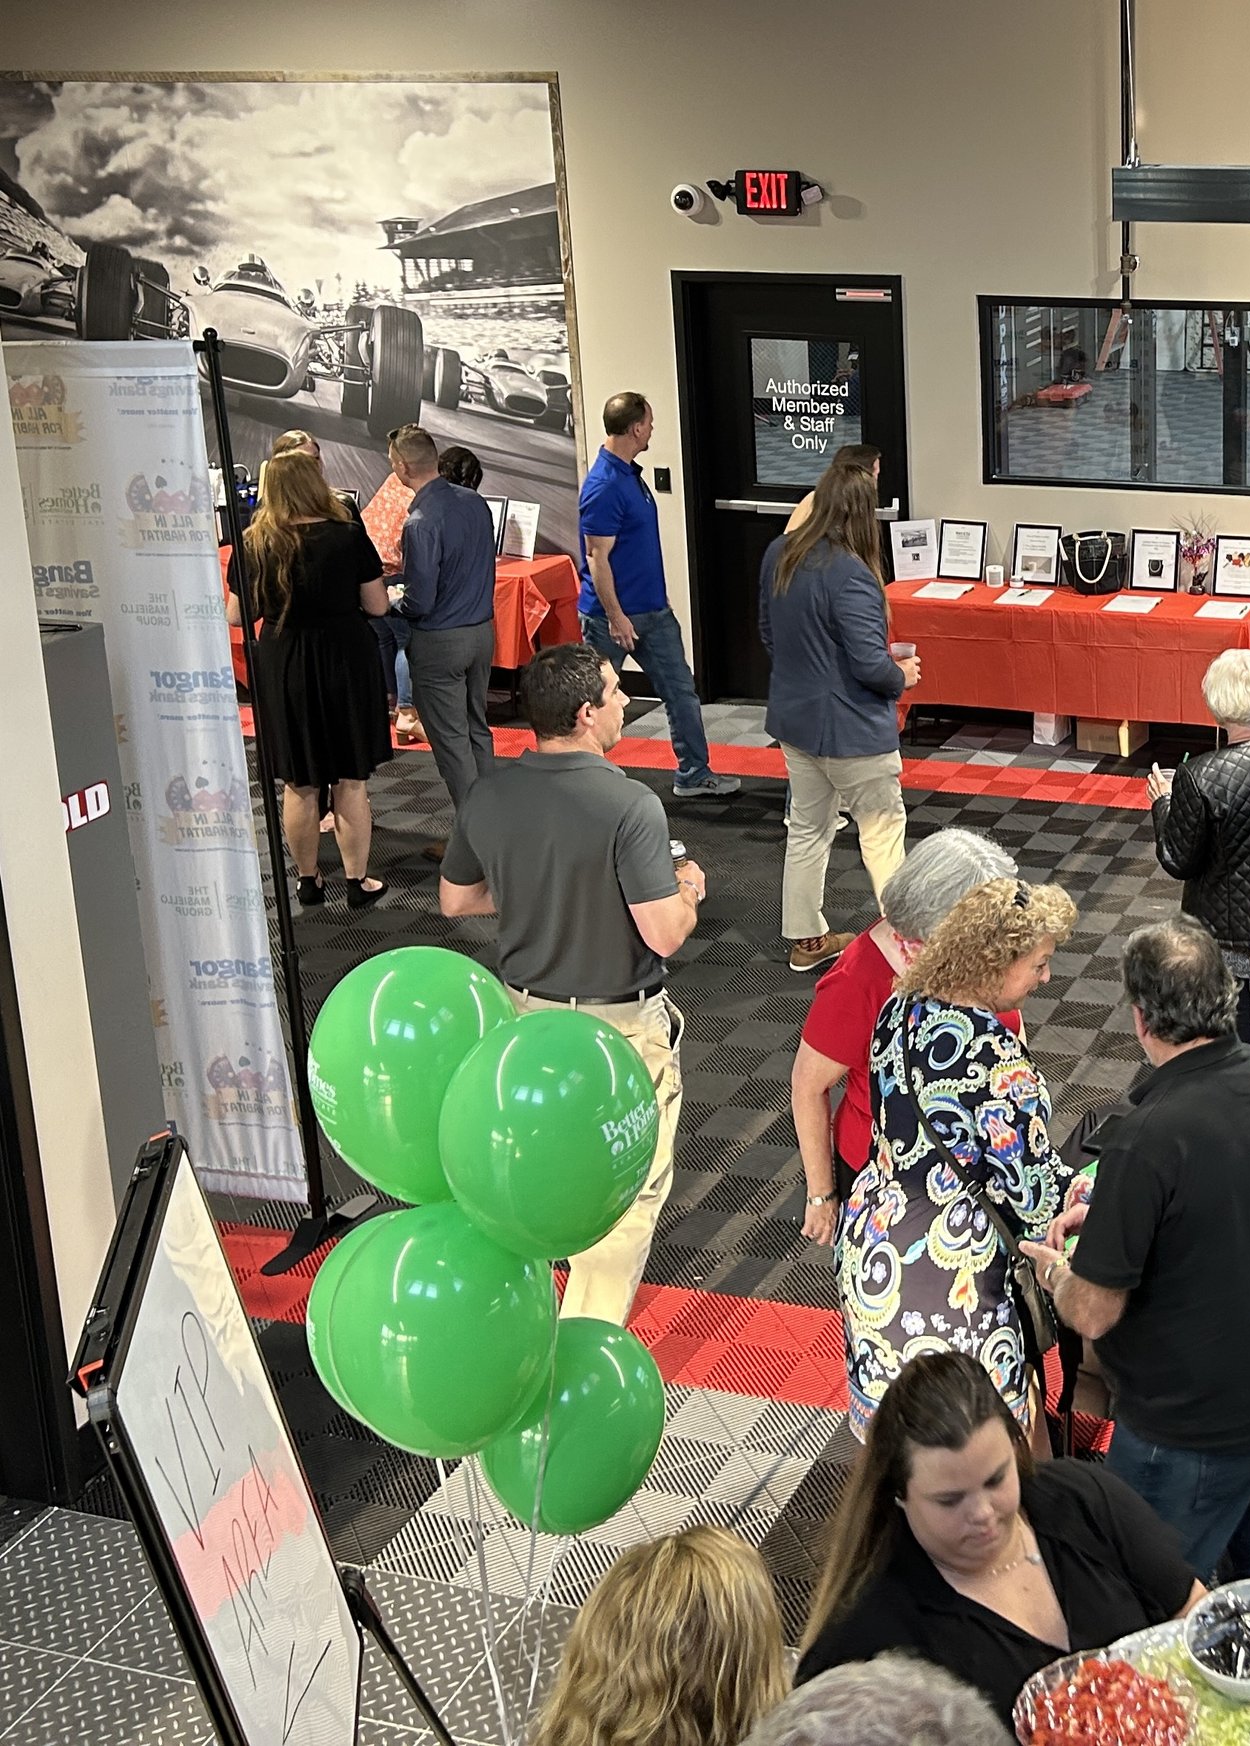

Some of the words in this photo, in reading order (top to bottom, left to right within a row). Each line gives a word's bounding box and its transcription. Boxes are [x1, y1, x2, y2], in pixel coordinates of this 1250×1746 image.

[745, 172, 788, 209] EXIT
[765, 378, 849, 397] Authorized
[772, 396, 845, 415] Members
[783, 414, 795, 431] &
[800, 415, 835, 433] Staff
[791, 433, 828, 454] Only
[600, 1099, 646, 1143] Better
[154, 1311, 225, 1551] VIP
